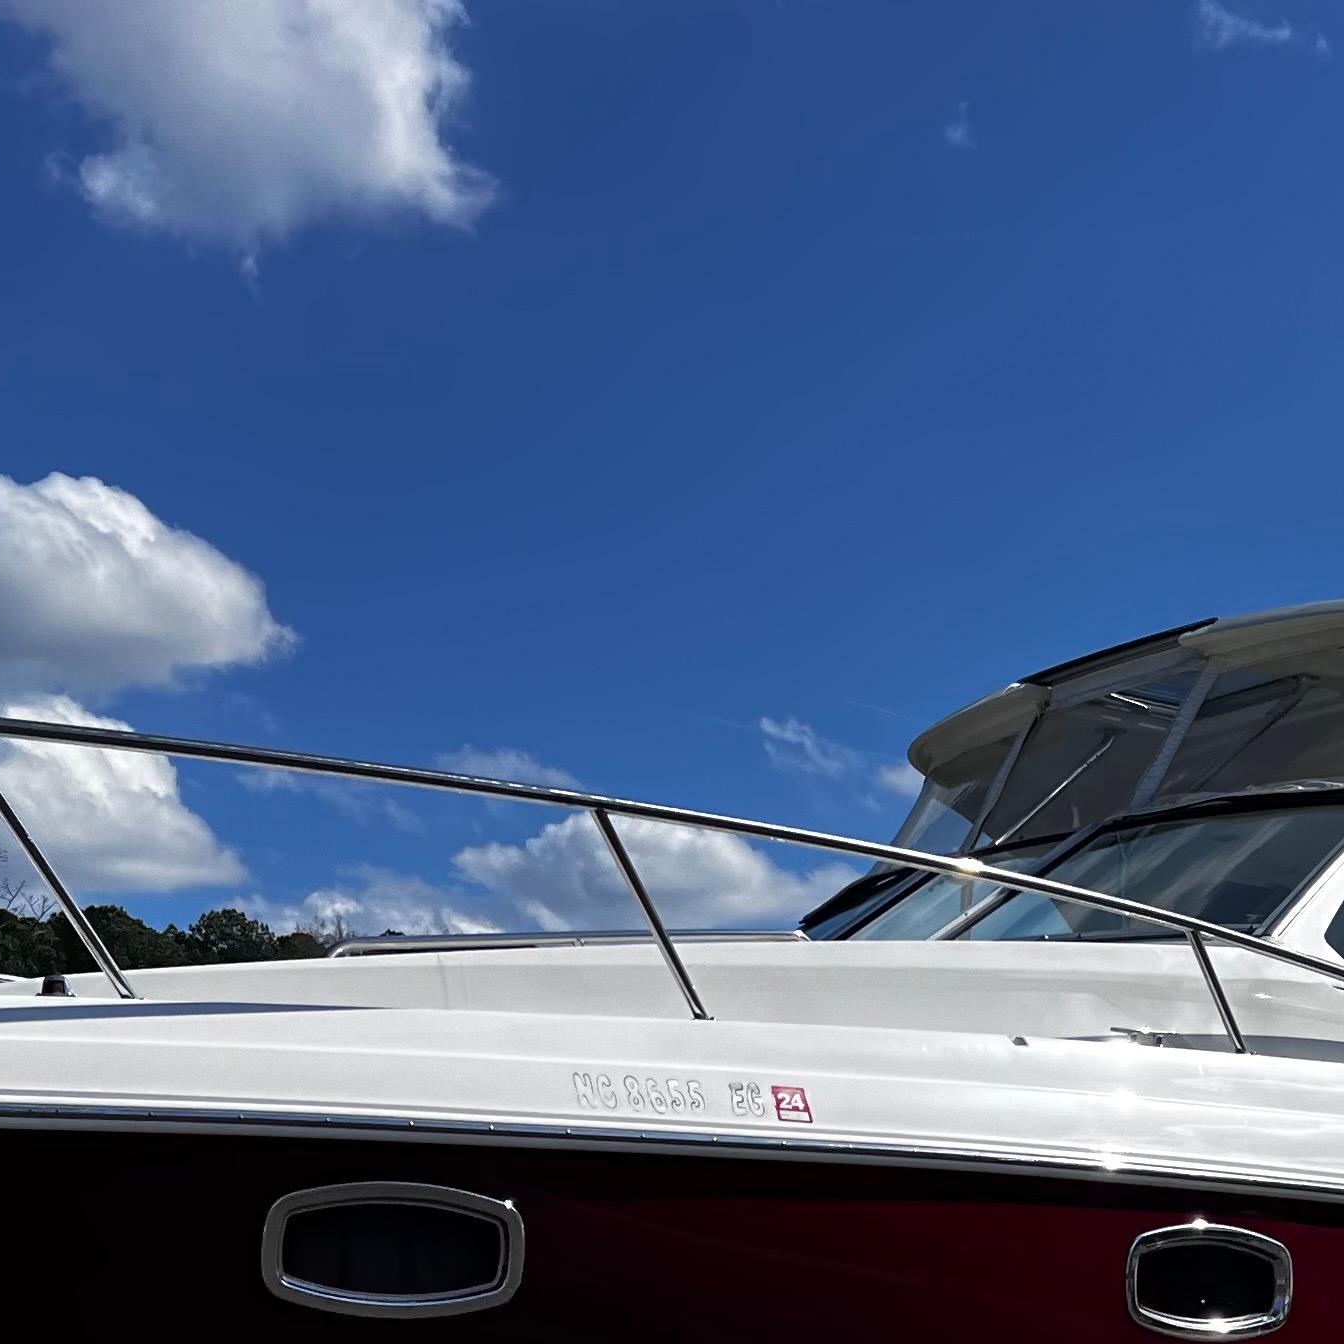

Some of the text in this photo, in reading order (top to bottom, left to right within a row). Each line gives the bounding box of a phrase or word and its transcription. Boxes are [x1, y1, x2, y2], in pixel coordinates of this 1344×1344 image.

[572, 1072, 618, 1110] NC
[622, 1075, 706, 1114] 8655
[776, 1092, 805, 1111] 24
